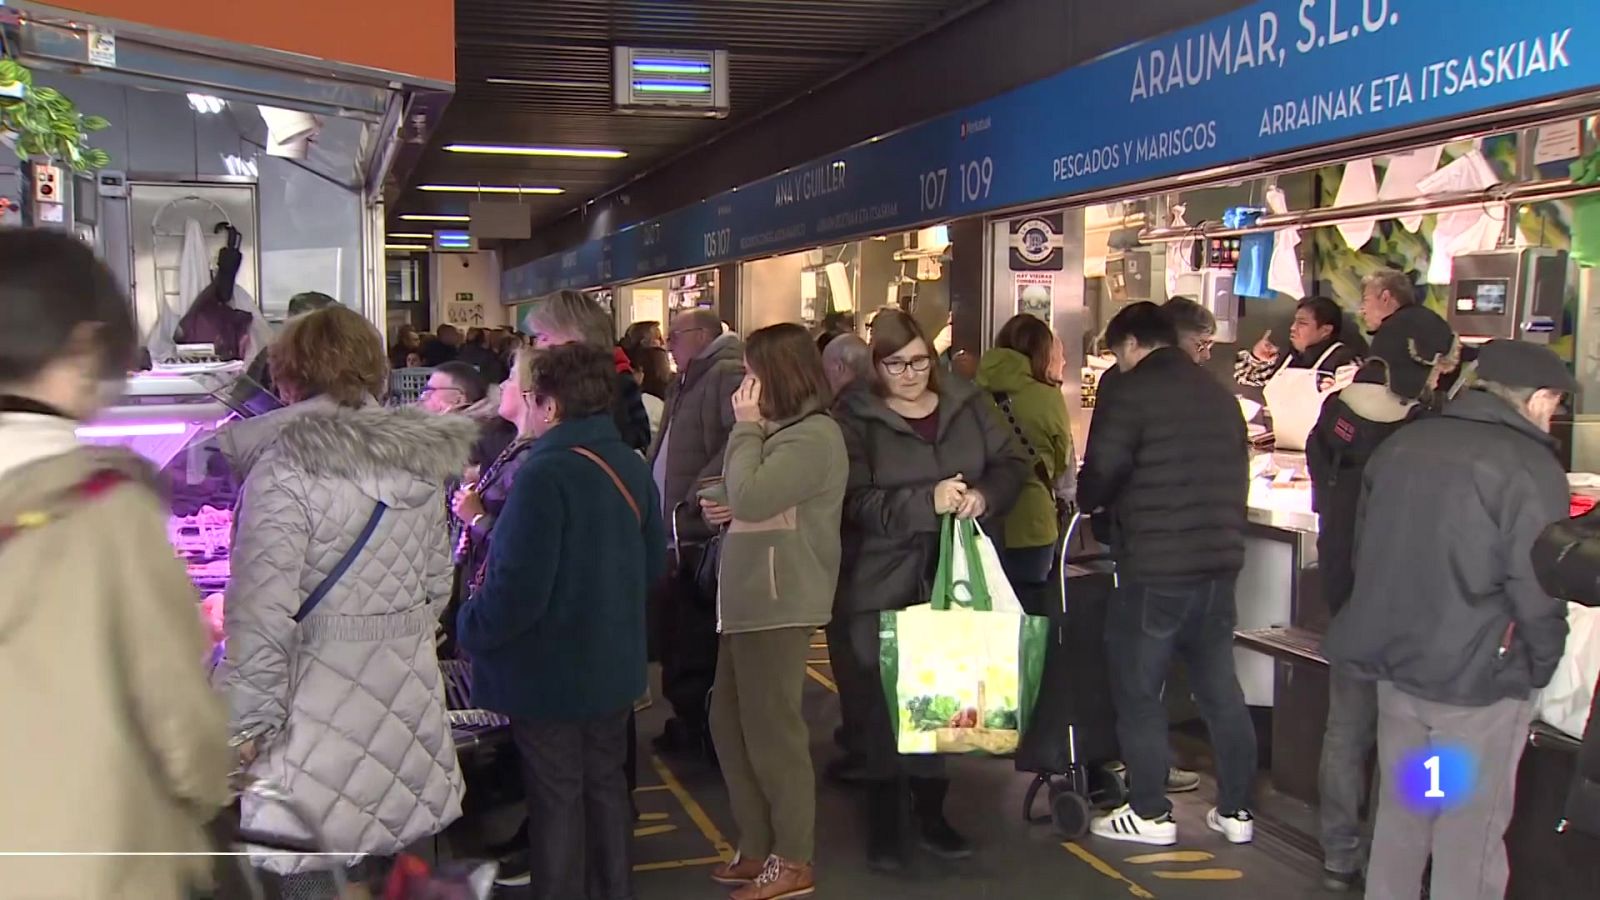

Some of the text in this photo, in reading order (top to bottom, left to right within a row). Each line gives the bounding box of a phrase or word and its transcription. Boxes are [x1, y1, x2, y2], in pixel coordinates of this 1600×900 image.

[1130, 11, 1286, 103] ARAUMAR,
[1258, 28, 1573, 137] ARRAINAK ETA ITSASKIAK
[1053, 120, 1217, 182] PESCADOS Y MARISCOS
[774, 161, 846, 209] ANA Y GUILLER
[919, 167, 947, 213] 107
[959, 155, 993, 204] 109
[703, 231, 717, 259] 105
[717, 227, 731, 258] 107
